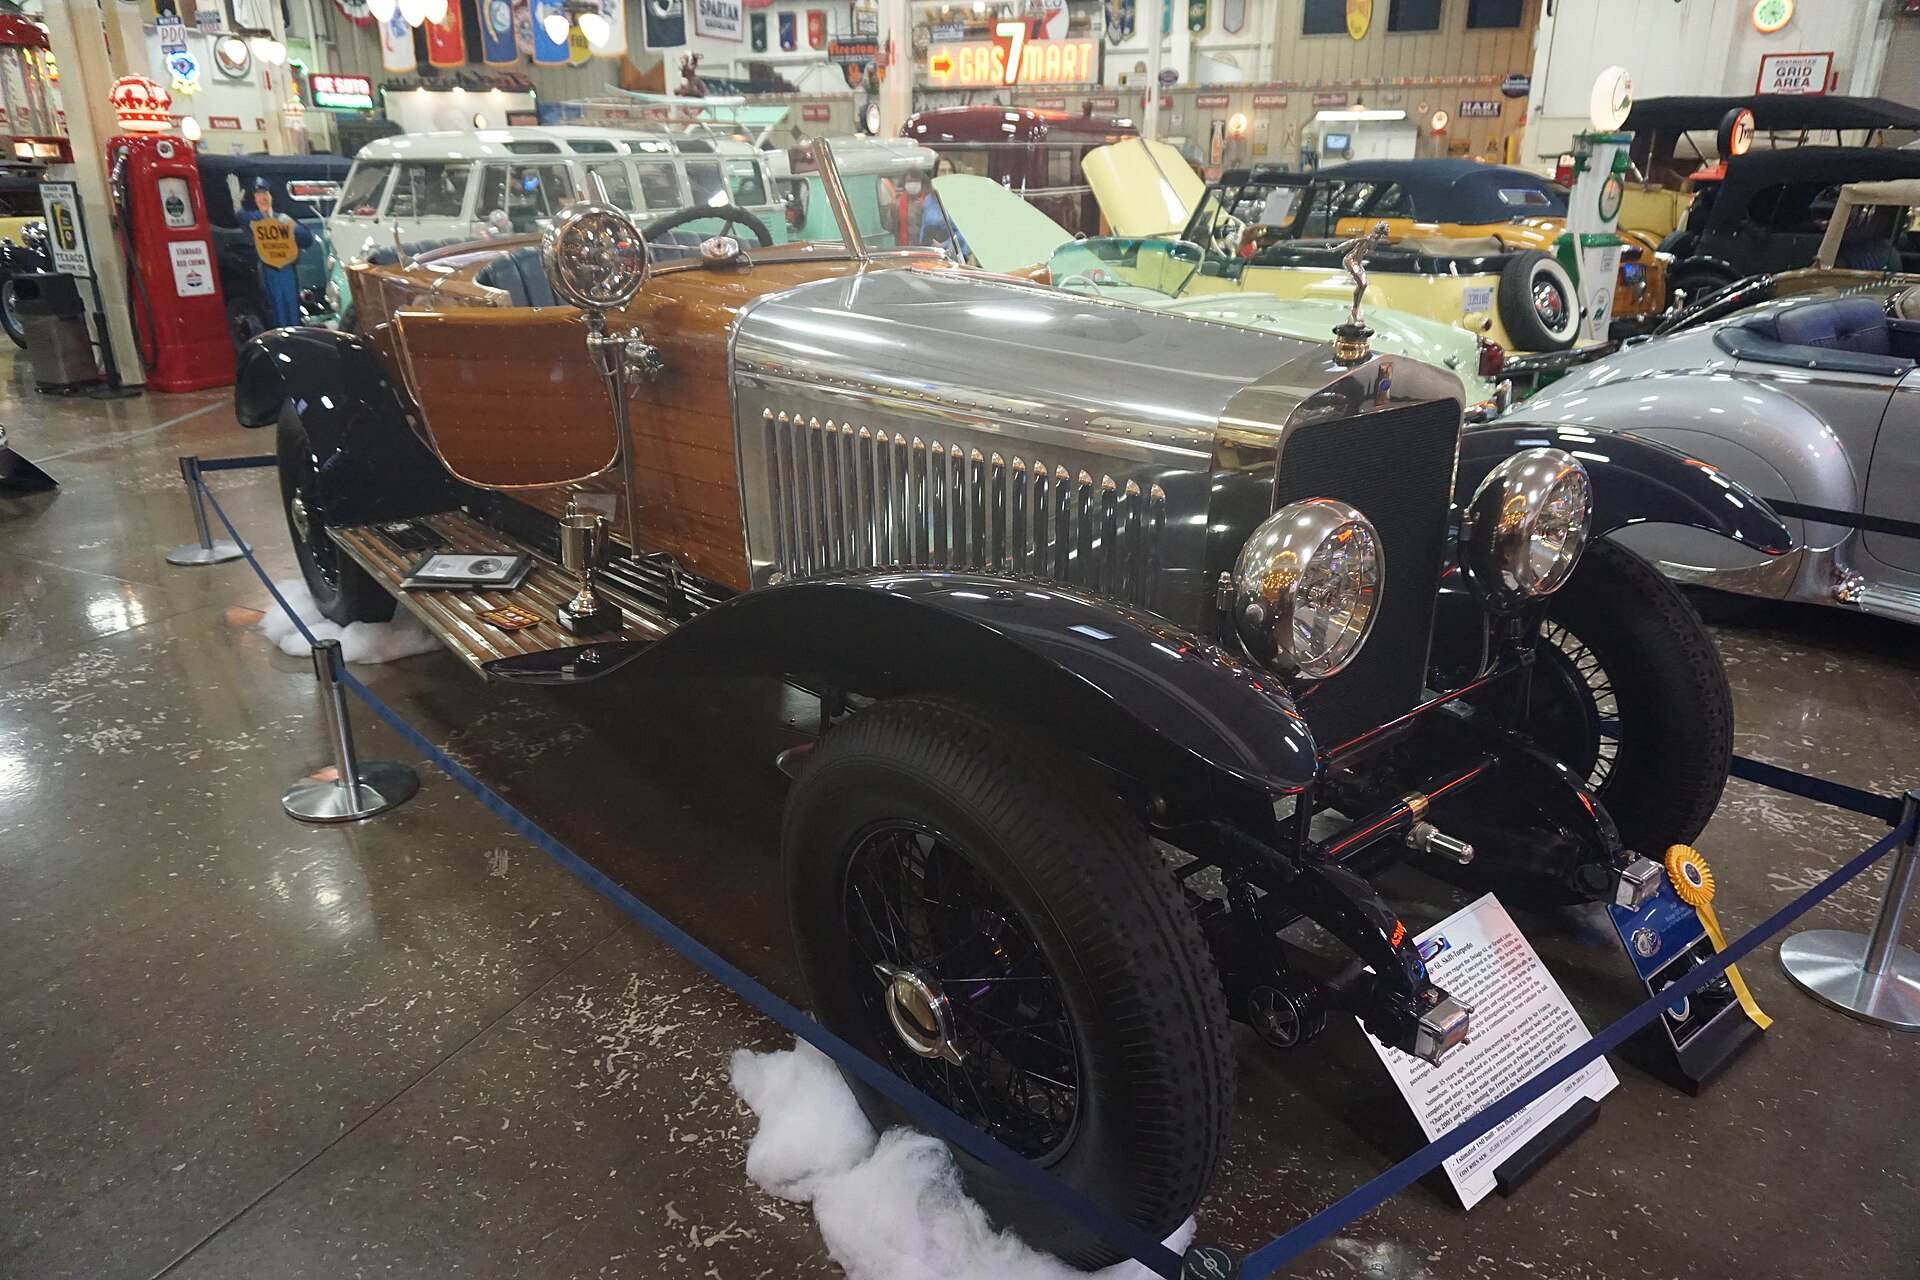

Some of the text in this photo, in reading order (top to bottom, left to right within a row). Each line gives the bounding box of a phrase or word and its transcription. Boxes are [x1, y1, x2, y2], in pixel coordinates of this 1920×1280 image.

[699, 0, 739, 21] SPARTAN
[161, 27, 187, 47] PDQ
[959, 22, 1093, 85] GAS 7 MART
[1776, 66, 1812, 77] GRID
[314, 76, 335, 92] DE
[335, 78, 370, 95] SOTO
[1773, 77, 1810, 88] AREA
[1462, 102, 1500, 110] HART
[257, 225, 289, 240] SLOW
[56, 252, 84, 263] TEXACO
[176, 248, 202, 256] STANDARD
[1434, 961, 1442, 969] GL
[1452, 985, 1460, 993] and
[1425, 1103, 1444, 1118] complete
[1444, 1096, 1452, 1105] and
[1468, 1078, 1477, 1087] had
[1476, 1067, 1493, 1081] received
[1496, 1050, 1516, 1067] restoration
[1529, 1033, 1538, 1041] then
[1427, 1085, 1439, 1094] Some
[1445, 1072, 1457, 1082] years
[1465, 1058, 1475, 1067] Paul
[1462, 1070, 1474, 1080] being
[1473, 1063, 1483, 1072] used
[1471, 1088, 1479, 1096] has
[1479, 1080, 1489, 1090] made
[1490, 1063, 1513, 1082] appearances
[1453, 1112, 1461, 1121] and
[1495, 1077, 1509, 1088] French
[1524, 1058, 1533, 1067] class
[1494, 1089, 1506, 1101] award
[1456, 1145, 1476, 1164] Estimated
